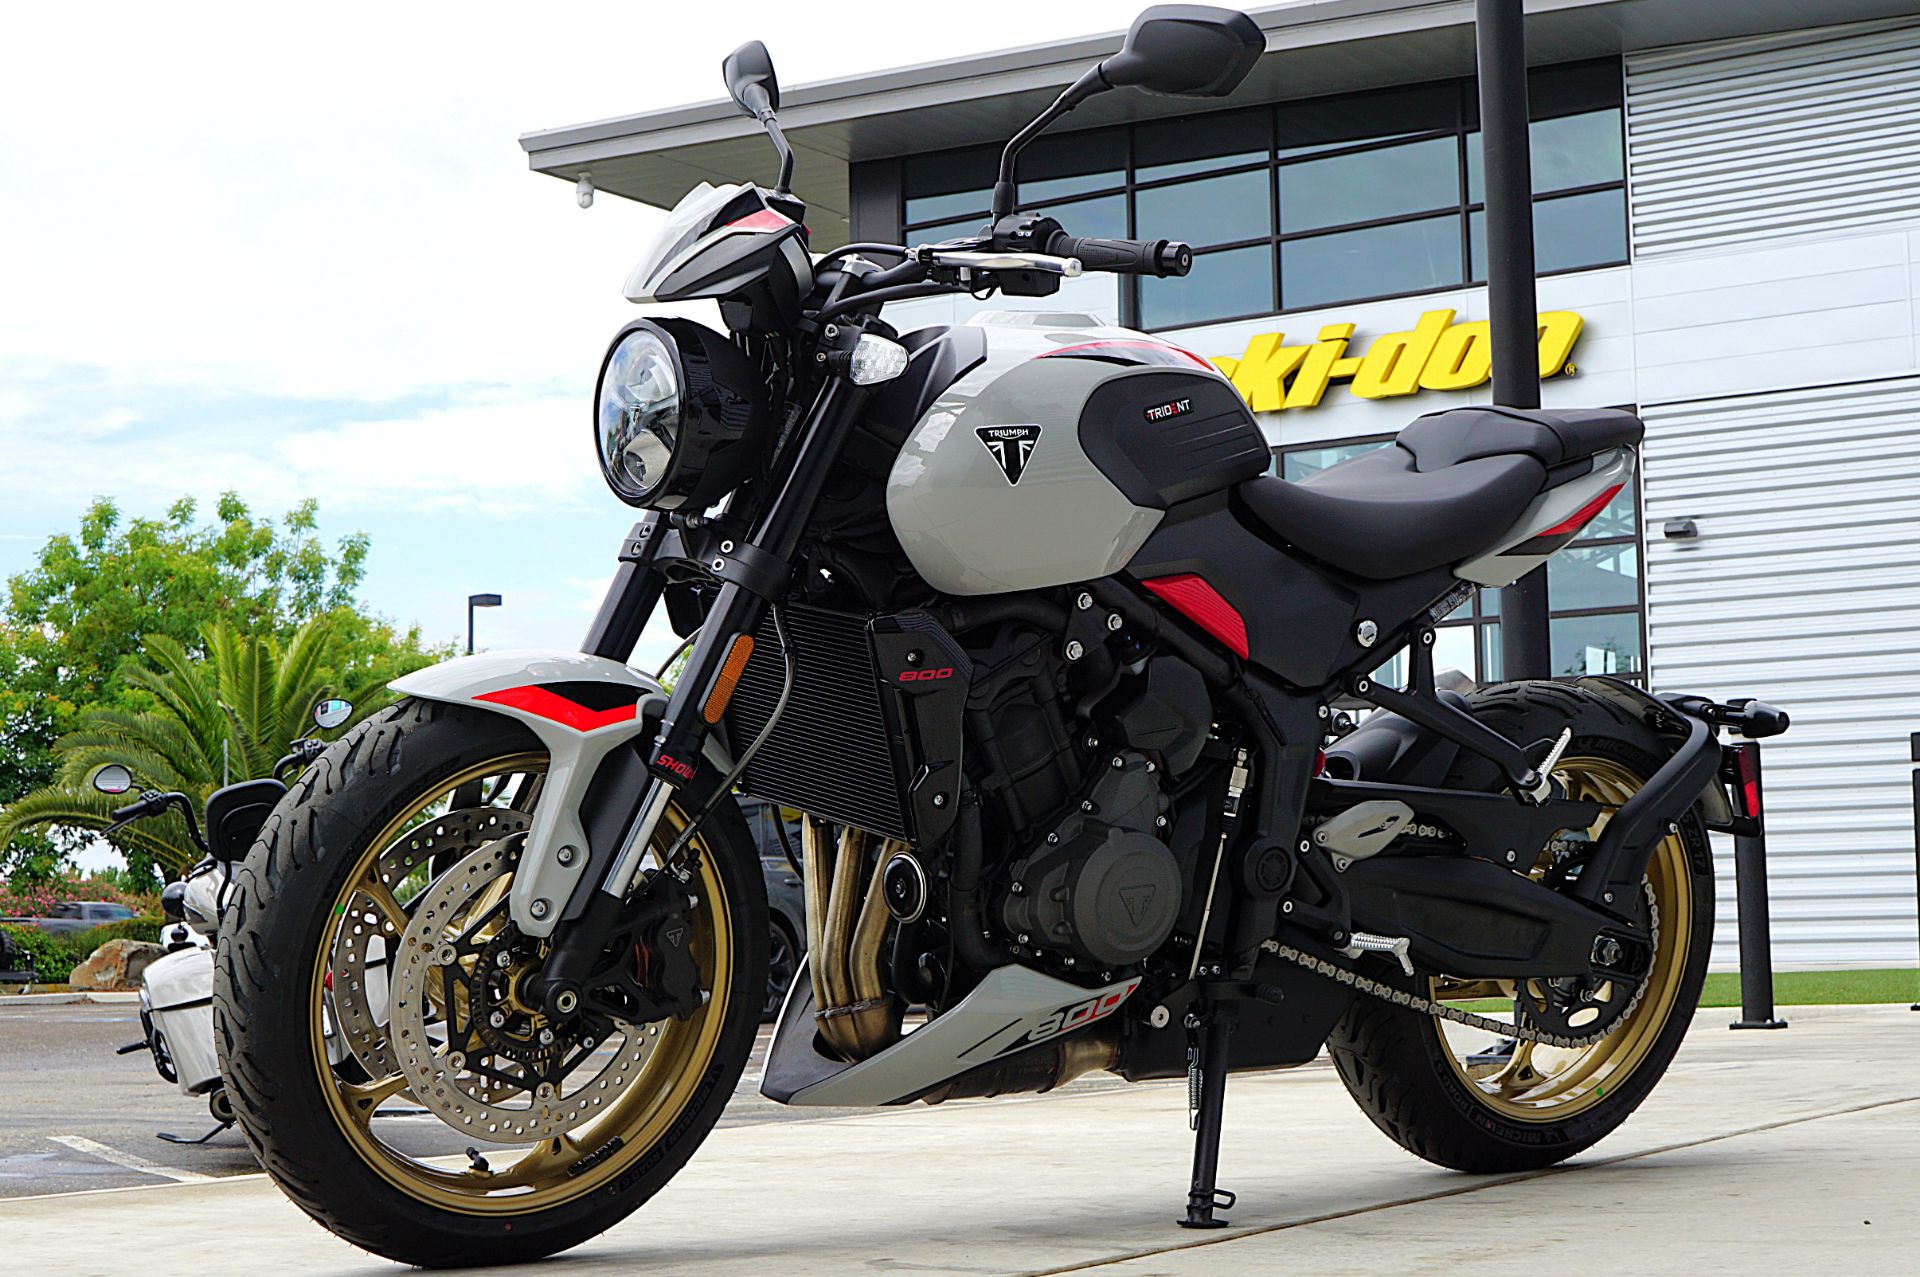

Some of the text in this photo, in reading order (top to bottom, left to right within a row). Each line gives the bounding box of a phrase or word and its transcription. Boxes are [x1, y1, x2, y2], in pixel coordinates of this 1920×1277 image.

[1147, 399, 1190, 421] TRIDENT
[988, 428, 1029, 439] TRIUMPH
[898, 667, 954, 682] 800
[1028, 990, 1125, 1042] 800
